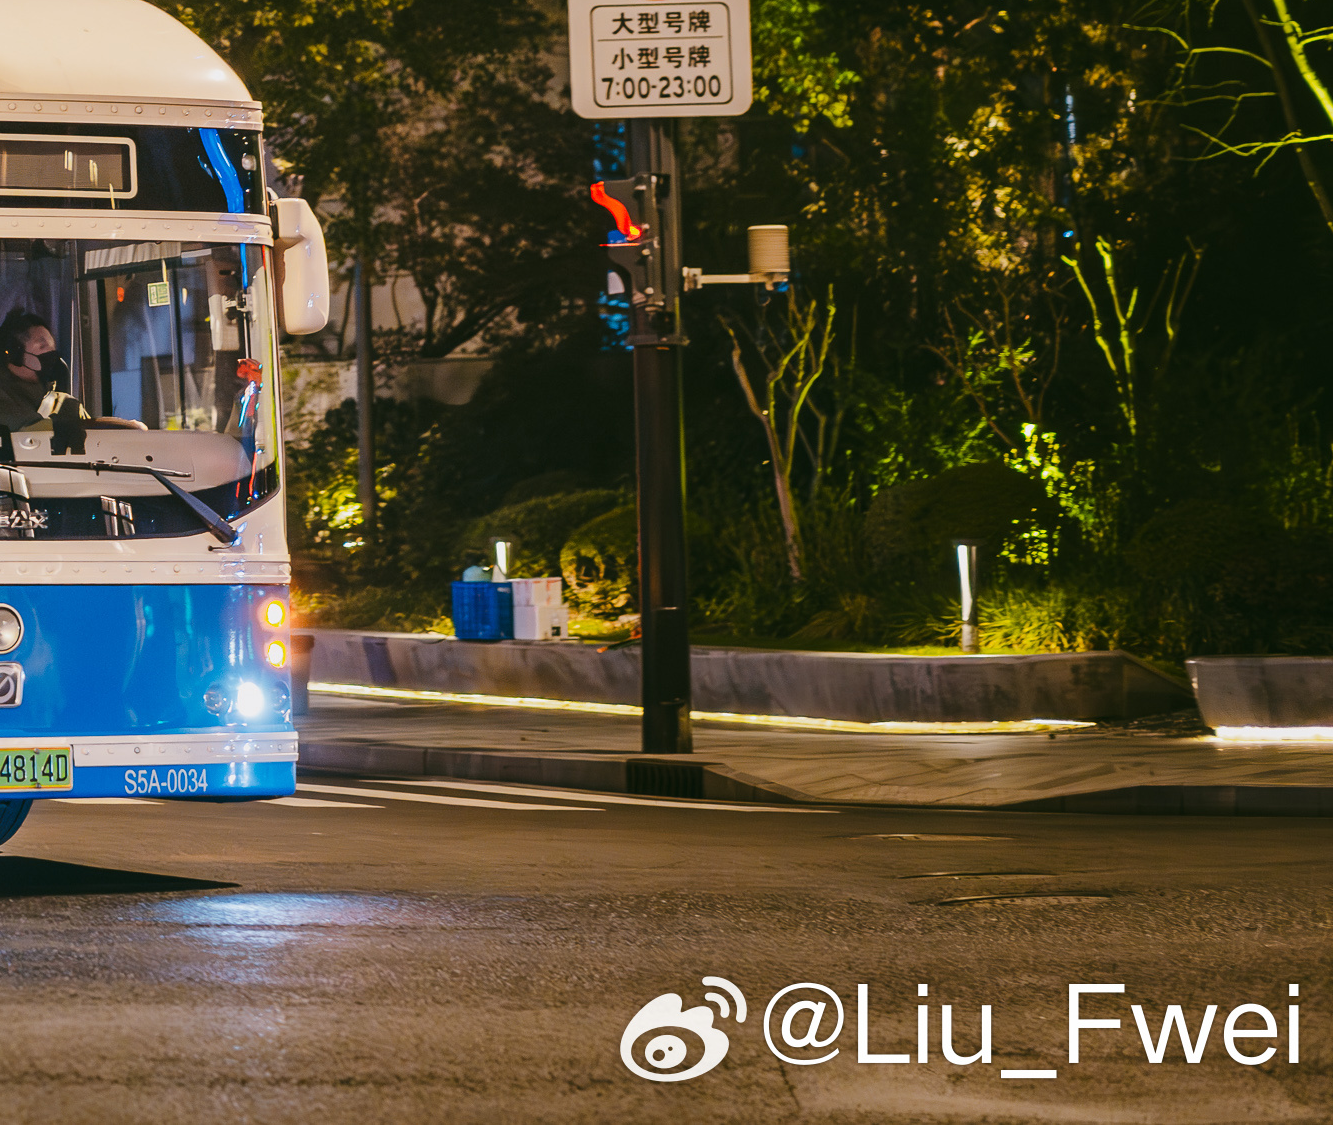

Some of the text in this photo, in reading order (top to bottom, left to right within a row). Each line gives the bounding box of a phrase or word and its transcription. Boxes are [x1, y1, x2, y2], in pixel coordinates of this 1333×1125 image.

[611, 10, 712, 35] 大型号牌
[611, 45, 712, 70] 小型号牌
[601, 75, 722, 100] 7:00-23:00
[124, 768, 208, 794] S5A-0034
